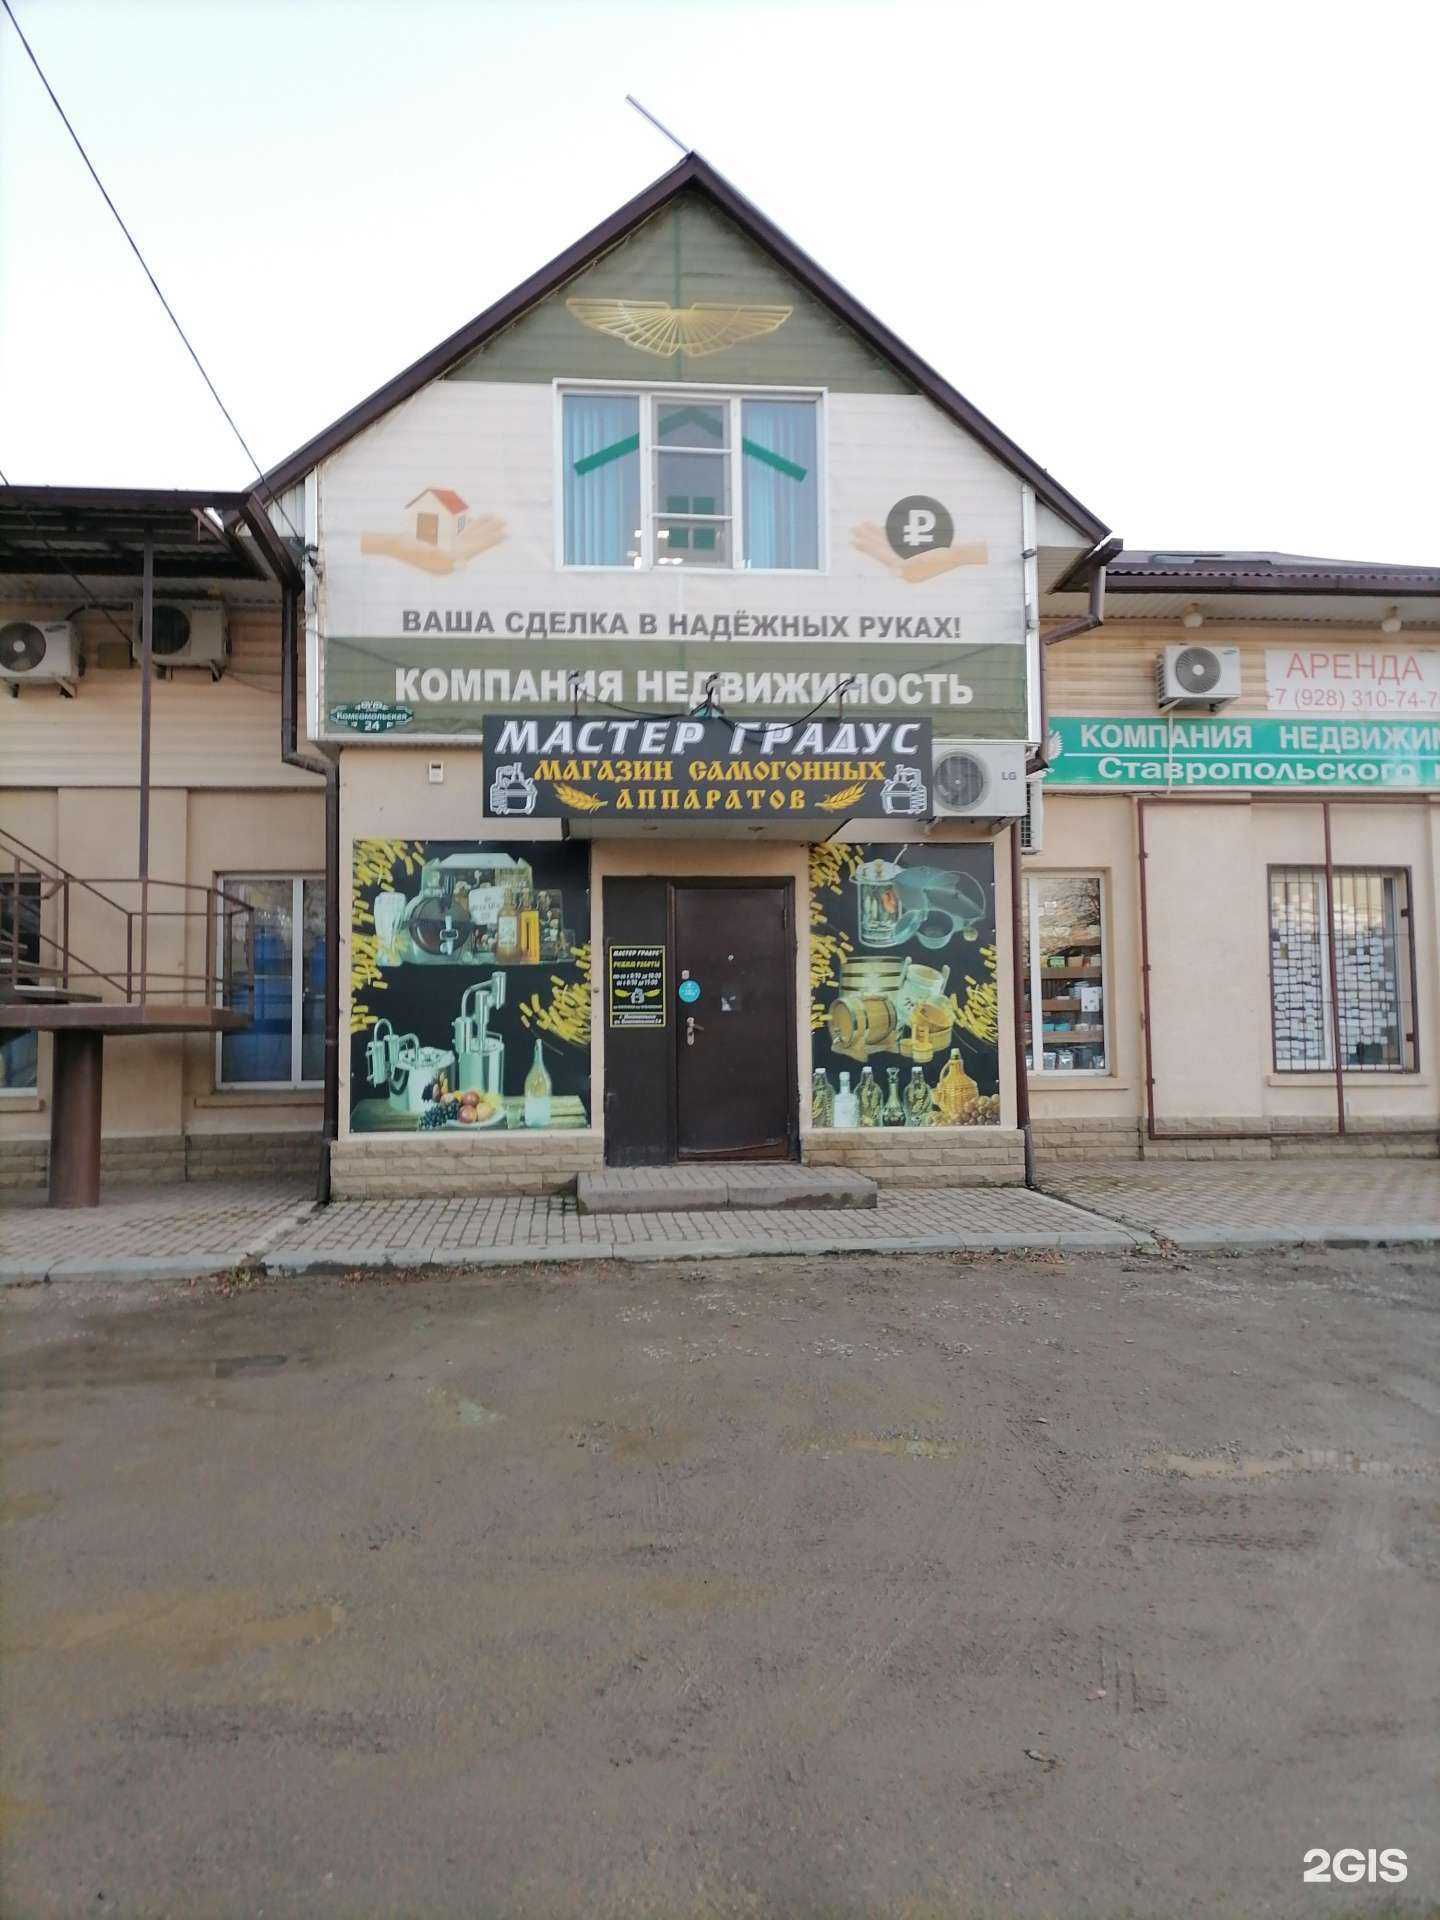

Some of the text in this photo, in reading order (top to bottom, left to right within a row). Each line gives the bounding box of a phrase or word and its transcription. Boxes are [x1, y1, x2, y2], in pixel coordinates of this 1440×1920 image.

[402, 609, 961, 640] ВАША СДЕЛКА В НАДЁЖНЫХ РУКАХ!
[1286, 652, 1423, 686] АРЕНДА
[395, 667, 975, 706] КОМПАНИЯ НЕДВИЖИМОСТЬ
[1294, 688, 1345, 711] (928)
[364, 720, 380, 731] 24
[494, 719, 922, 757] МАСТЕР ГРАДУС
[1080, 724, 1253, 749] КОМПАНИЯ
[533, 760, 886, 785] МАГАЗИН САМОГОННЫХ
[1001, 771, 1017, 781] LG
[1097, 757, 1418, 785] Ставропольского
[616, 788, 806, 811] АППАРАТОВ
